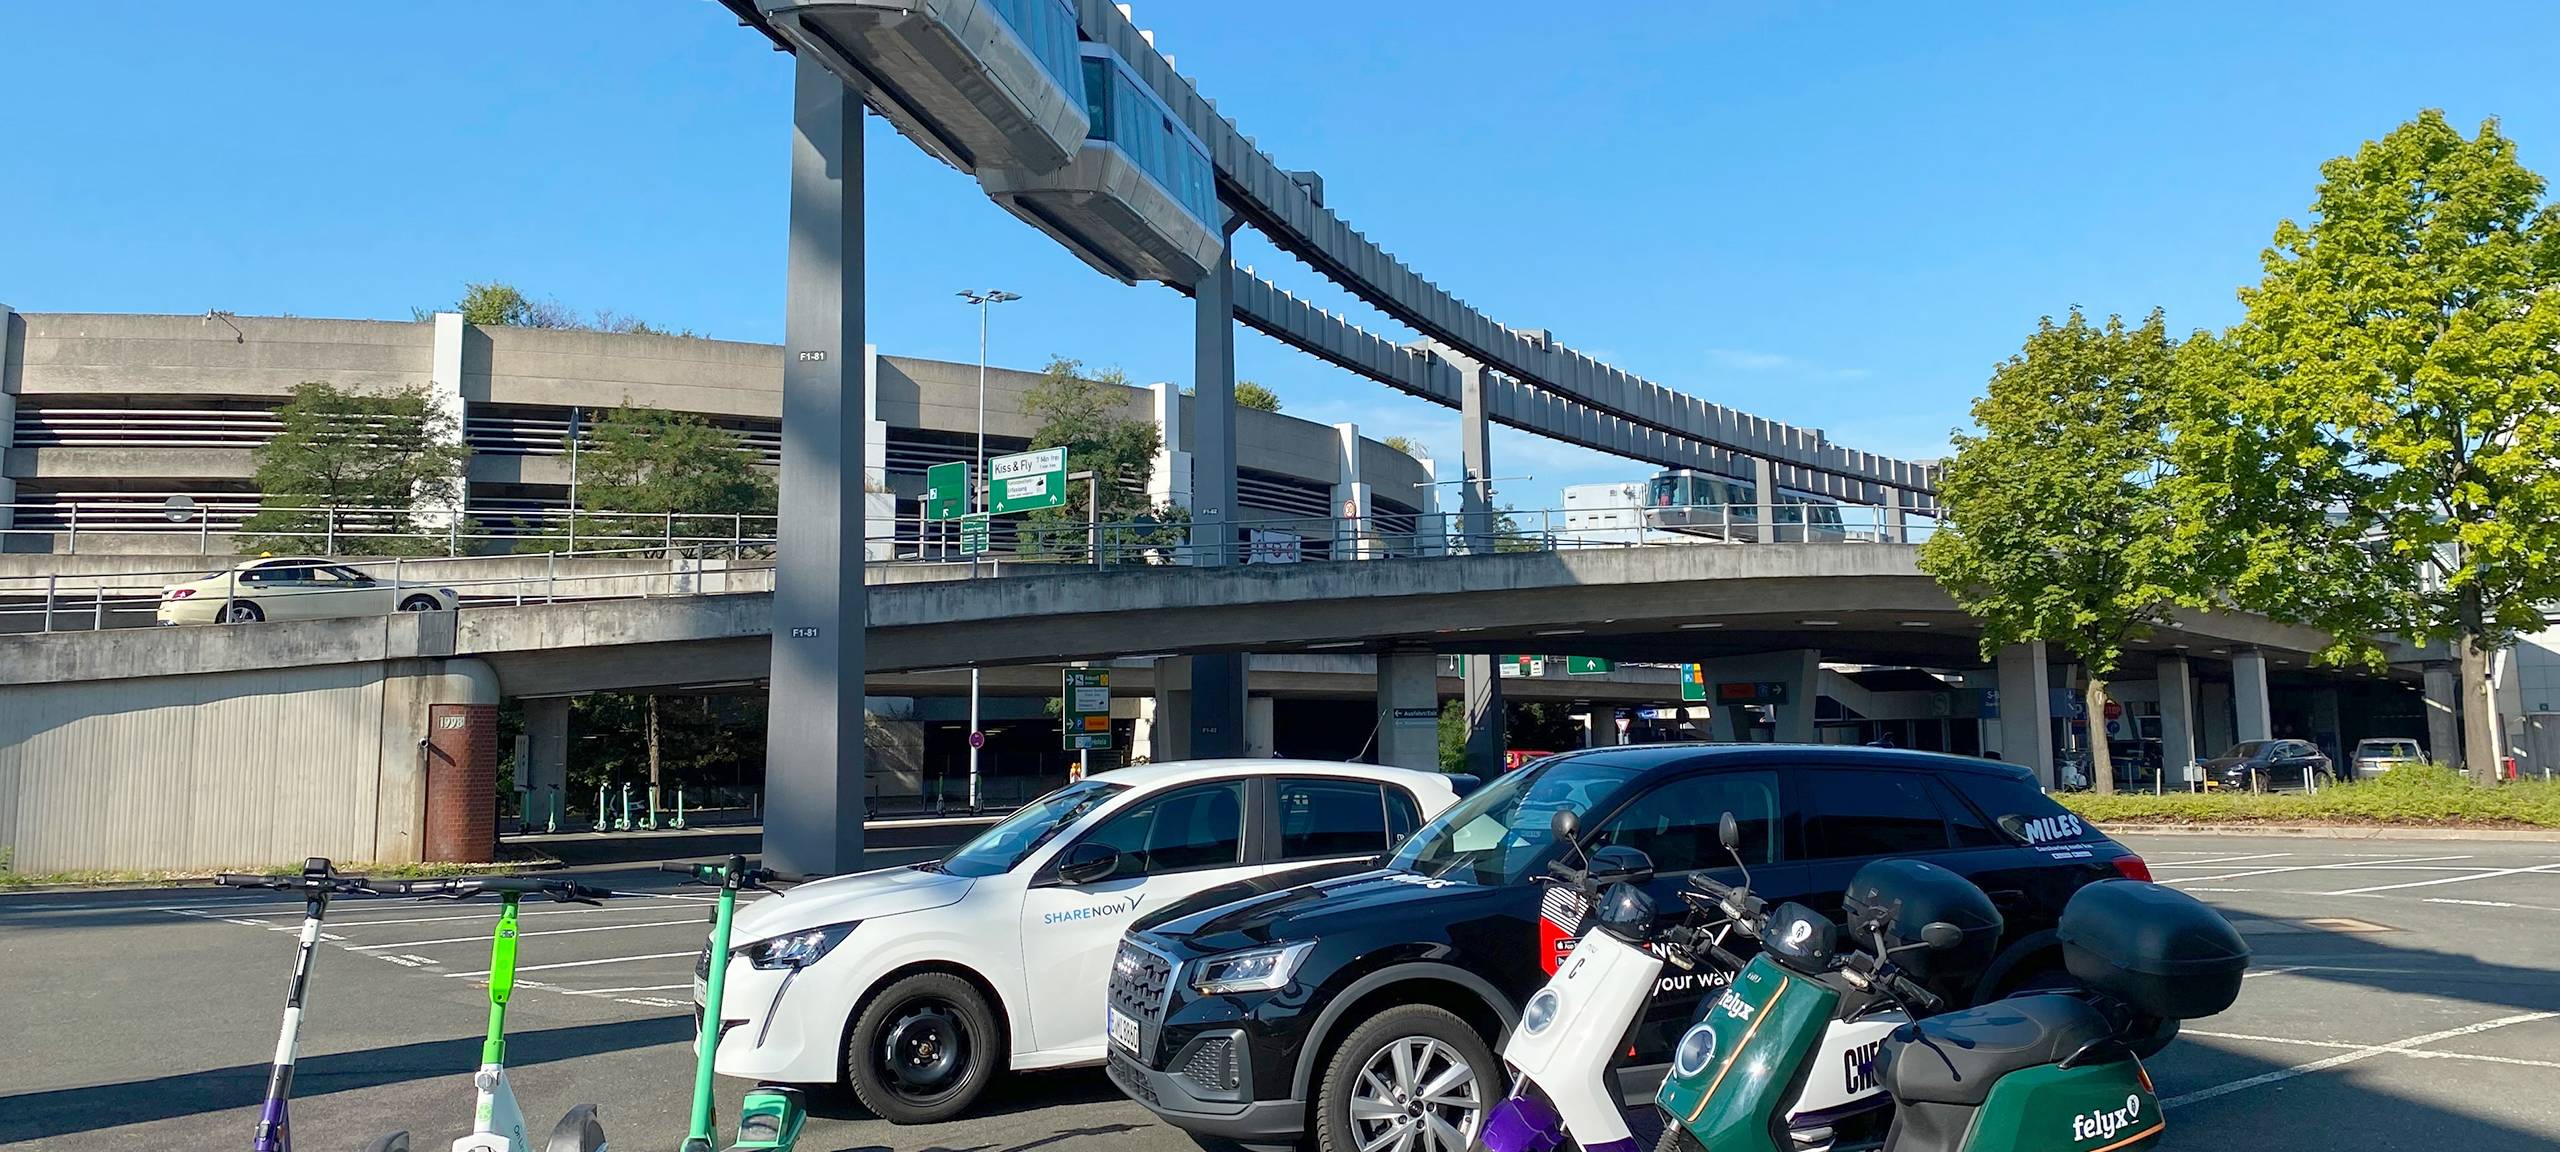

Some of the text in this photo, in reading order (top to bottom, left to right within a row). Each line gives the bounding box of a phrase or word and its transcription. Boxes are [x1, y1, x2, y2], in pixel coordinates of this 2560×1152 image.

[800, 352, 824, 361] F1-81
[995, 463, 1011, 475] Kiss
[1013, 461, 1019, 471] &
[1021, 459, 1032, 473] Fly
[792, 628, 817, 637] F1-81
[439, 716, 465, 728] 1998
[2025, 814, 2082, 844] MILES
[1044, 903, 1126, 925] SHARENOW
[1568, 958, 1586, 979] C
[1718, 988, 1755, 1021] felyx
[2073, 1107, 2129, 1141] felyx
